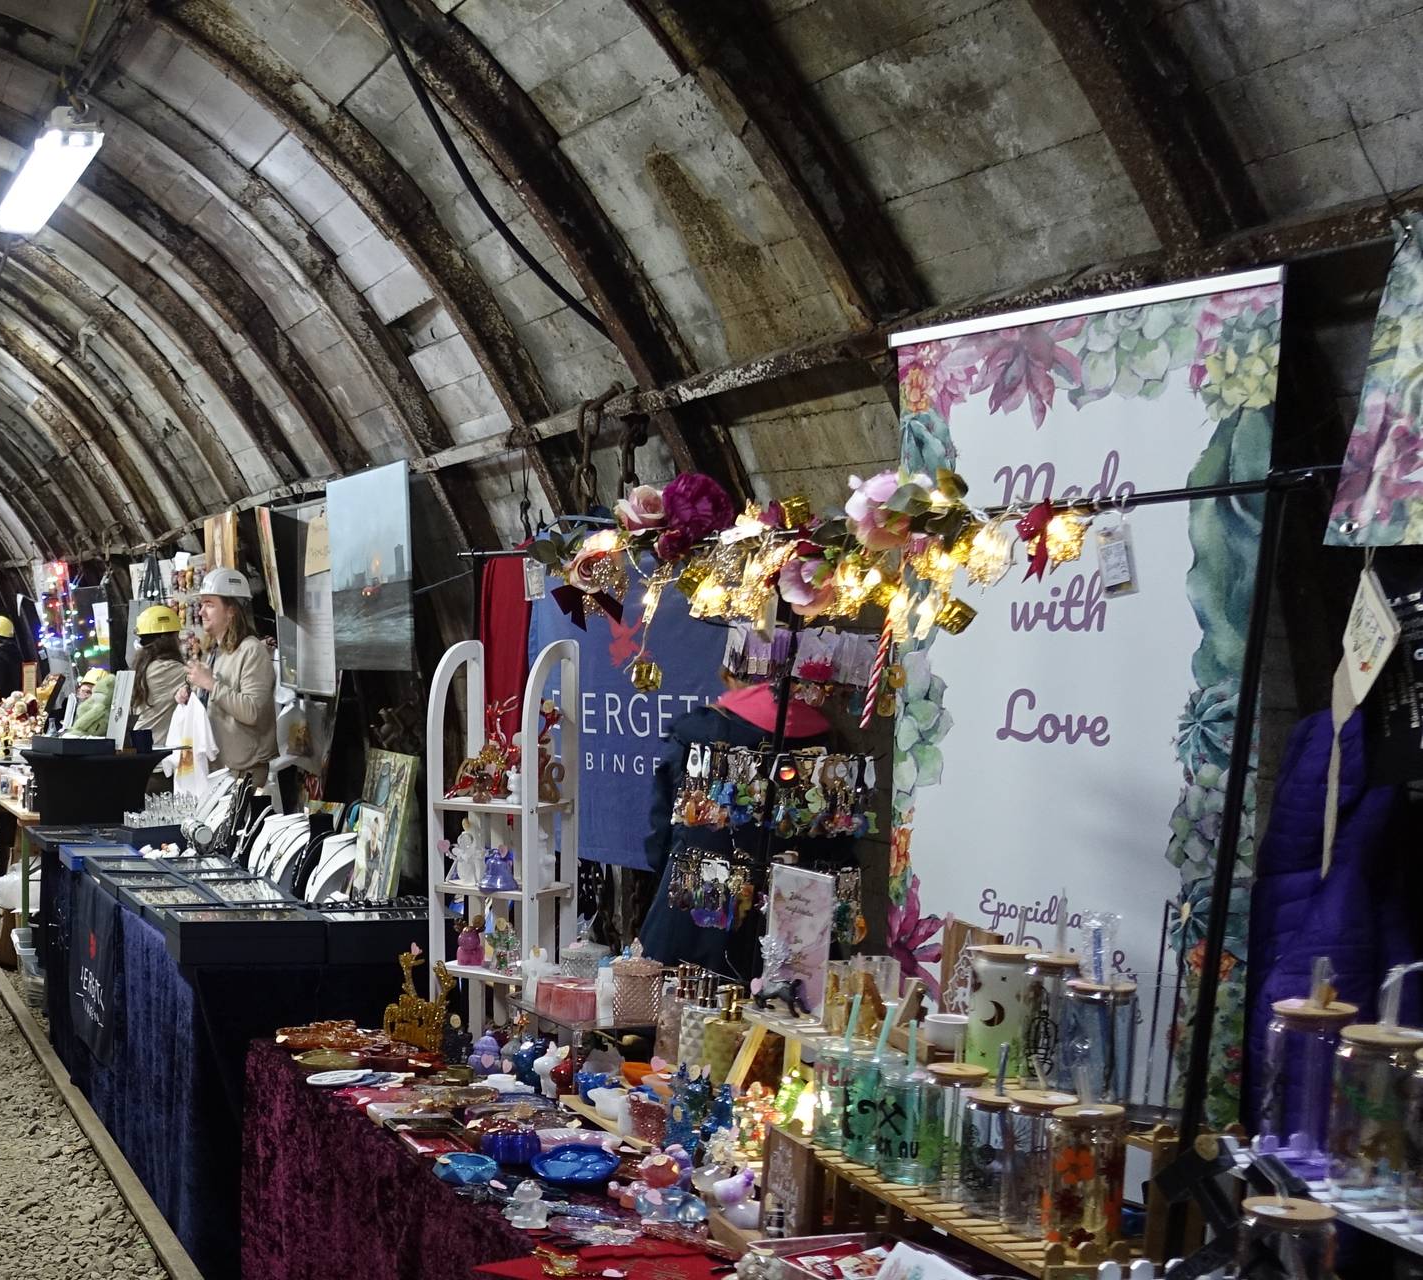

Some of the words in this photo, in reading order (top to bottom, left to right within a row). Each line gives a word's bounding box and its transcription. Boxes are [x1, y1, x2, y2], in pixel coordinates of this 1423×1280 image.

[993, 449, 1137, 515] Made
[1010, 570, 1107, 633] with
[996, 687, 1111, 747] Love
